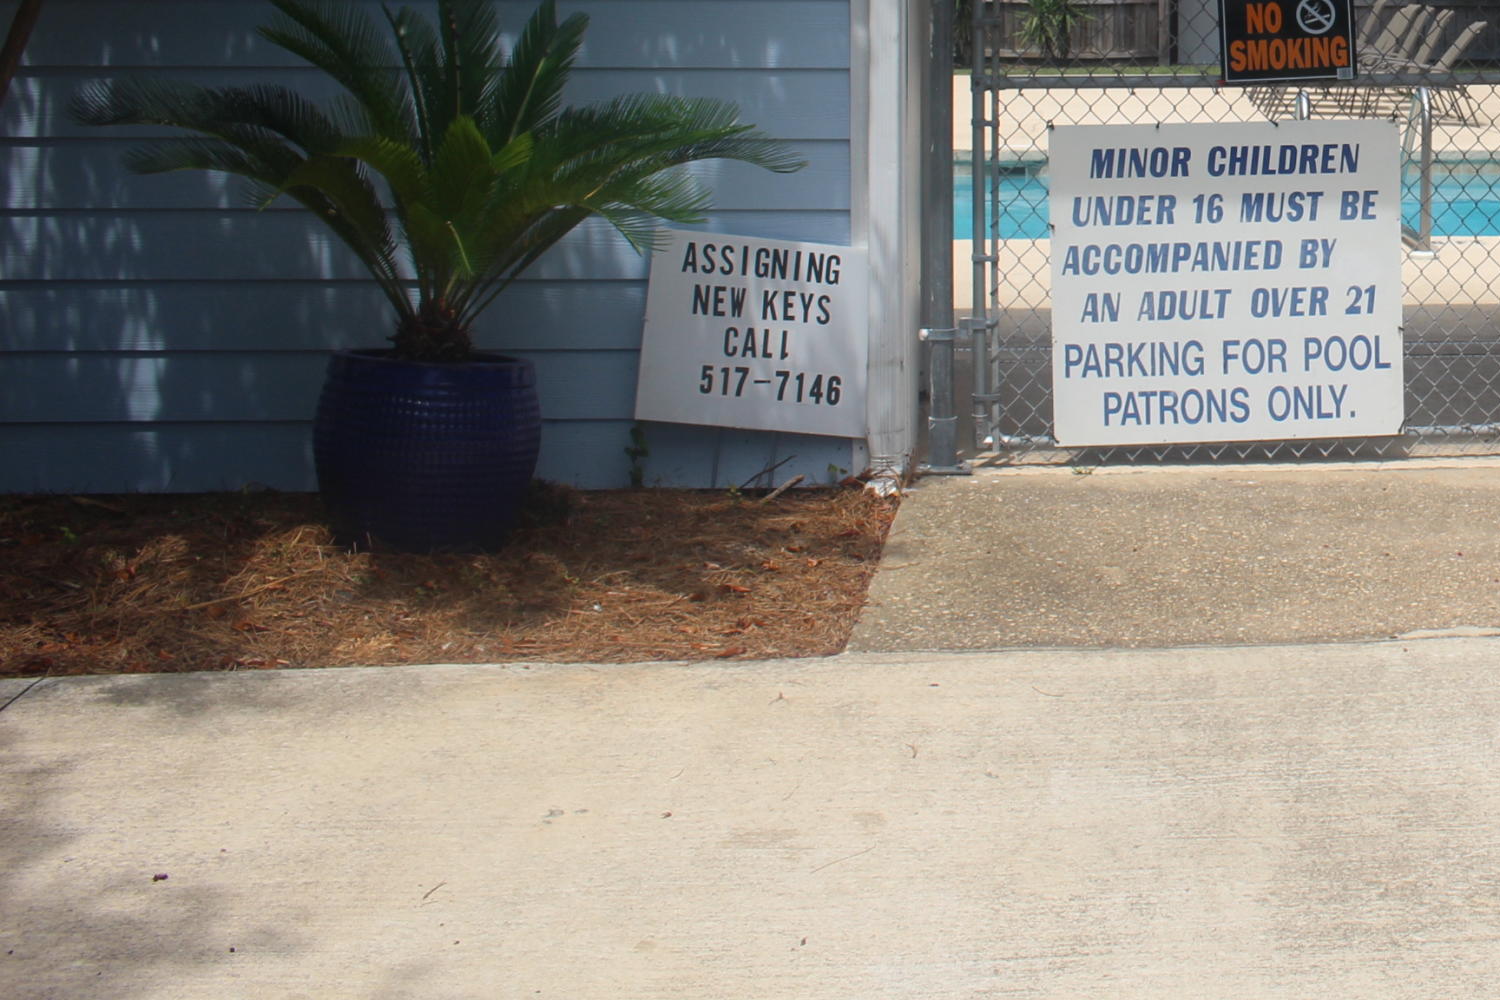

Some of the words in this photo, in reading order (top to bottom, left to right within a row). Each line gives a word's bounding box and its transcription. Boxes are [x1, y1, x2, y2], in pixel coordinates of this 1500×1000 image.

[1246, 2, 1282, 34] NO
[1230, 35, 1348, 72] SMOKING
[1090, 147, 1192, 179] MINOR
[1207, 143, 1360, 176] CHILDREN
[1072, 194, 1178, 227] UNDER
[1192, 193, 1224, 224] 16
[1240, 190, 1325, 223] MUST
[1339, 190, 1380, 221] BE
[681, 242, 842, 285] ASSIGNING
[1062, 239, 1284, 276] ACCOMPANIED
[1298, 238, 1338, 269] BY
[692, 284, 747, 318] NEW
[762, 289, 832, 325] KEYS
[1080, 292, 1121, 323] AN
[1137, 288, 1233, 322] ADULT
[1250, 286, 1330, 318] OVER
[1345, 284, 1378, 316] 21
[724, 326, 789, 360] CALL
[1064, 340, 1205, 378] PARKING
[1222, 338, 1288, 375] FOR
[1304, 334, 1392, 372] POOL
[699, 365, 842, 406] 517-7146
[1103, 386, 1251, 426] PATRONS
[1268, 384, 1356, 422] ONLY.
